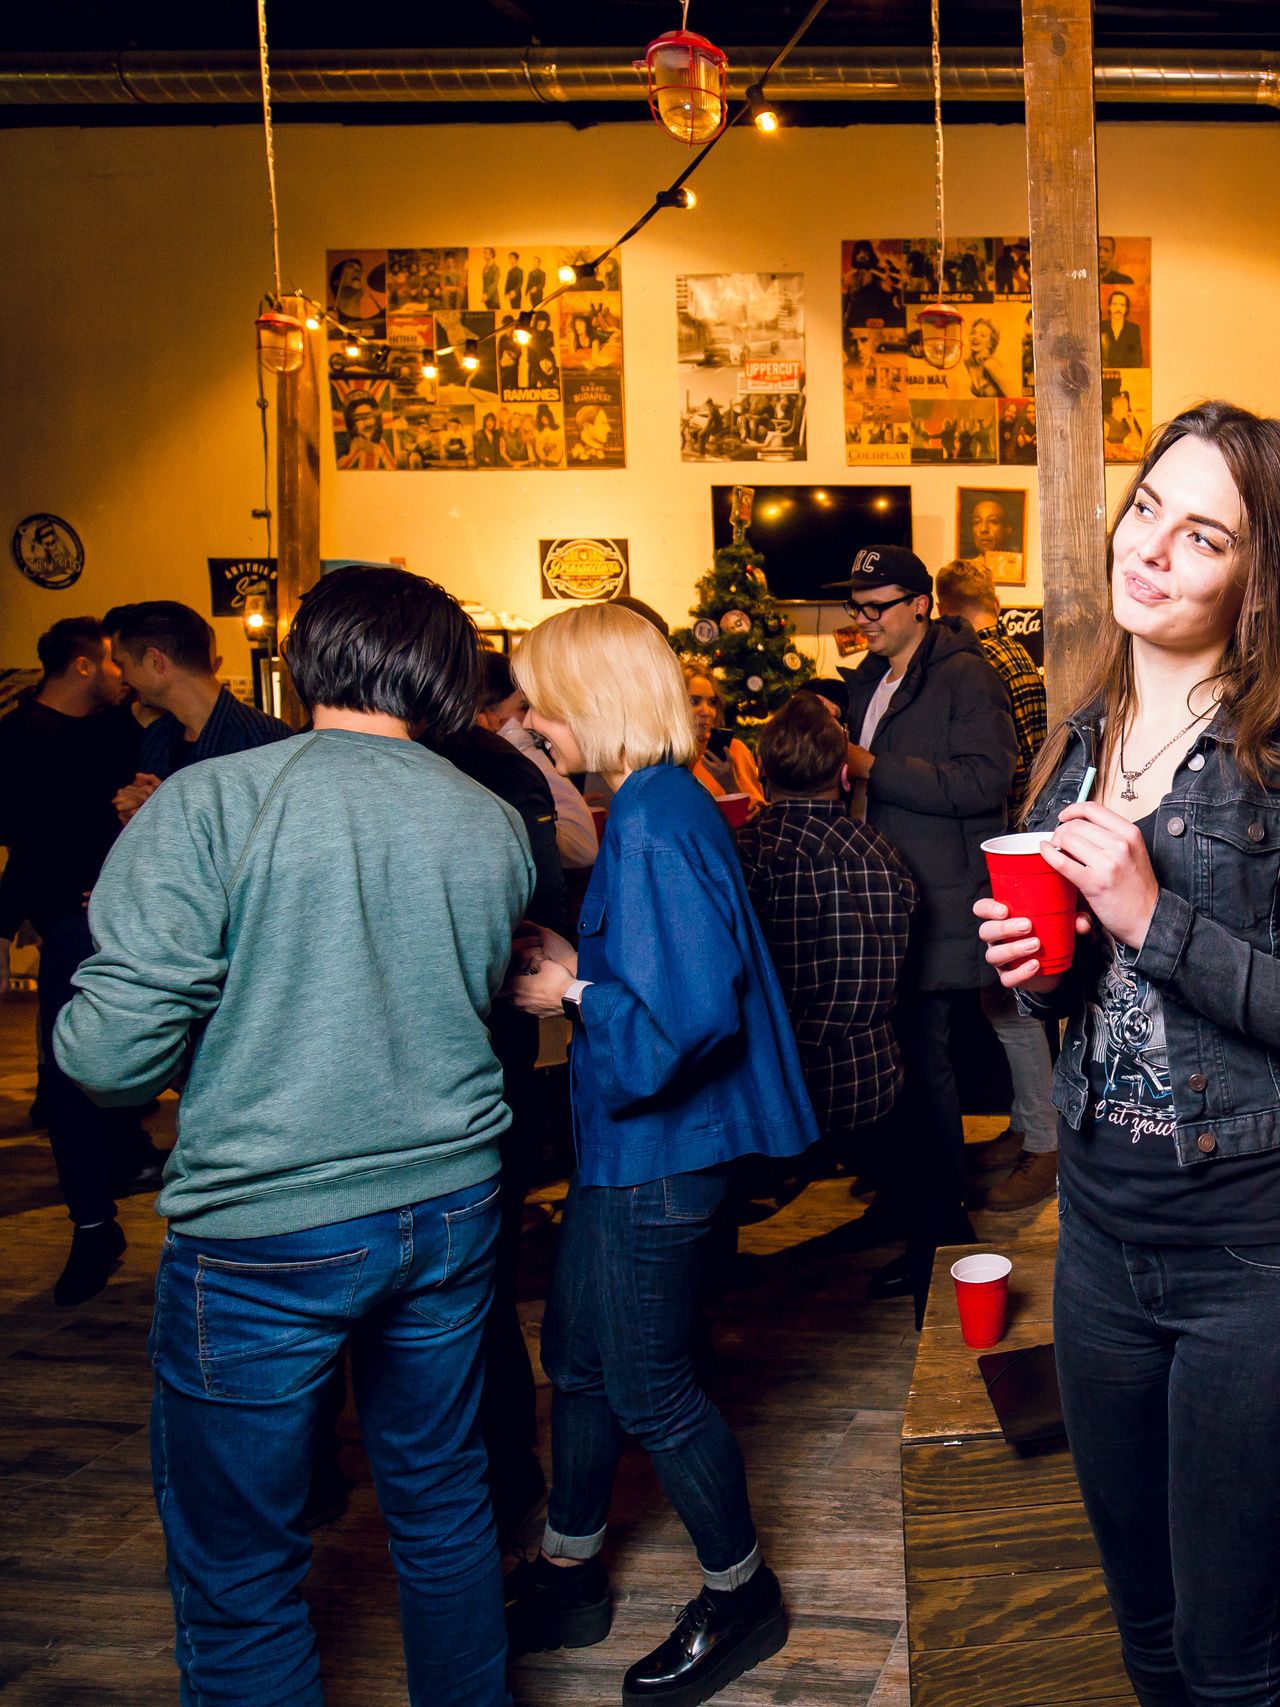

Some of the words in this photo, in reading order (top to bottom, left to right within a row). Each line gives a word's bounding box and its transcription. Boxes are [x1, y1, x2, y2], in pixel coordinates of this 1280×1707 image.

[920, 293, 974, 302] RADOHEAD
[746, 362, 799, 377] UPPERCUT
[503, 388, 560, 402] RAMONES
[1108, 1107, 1140, 1126] at
